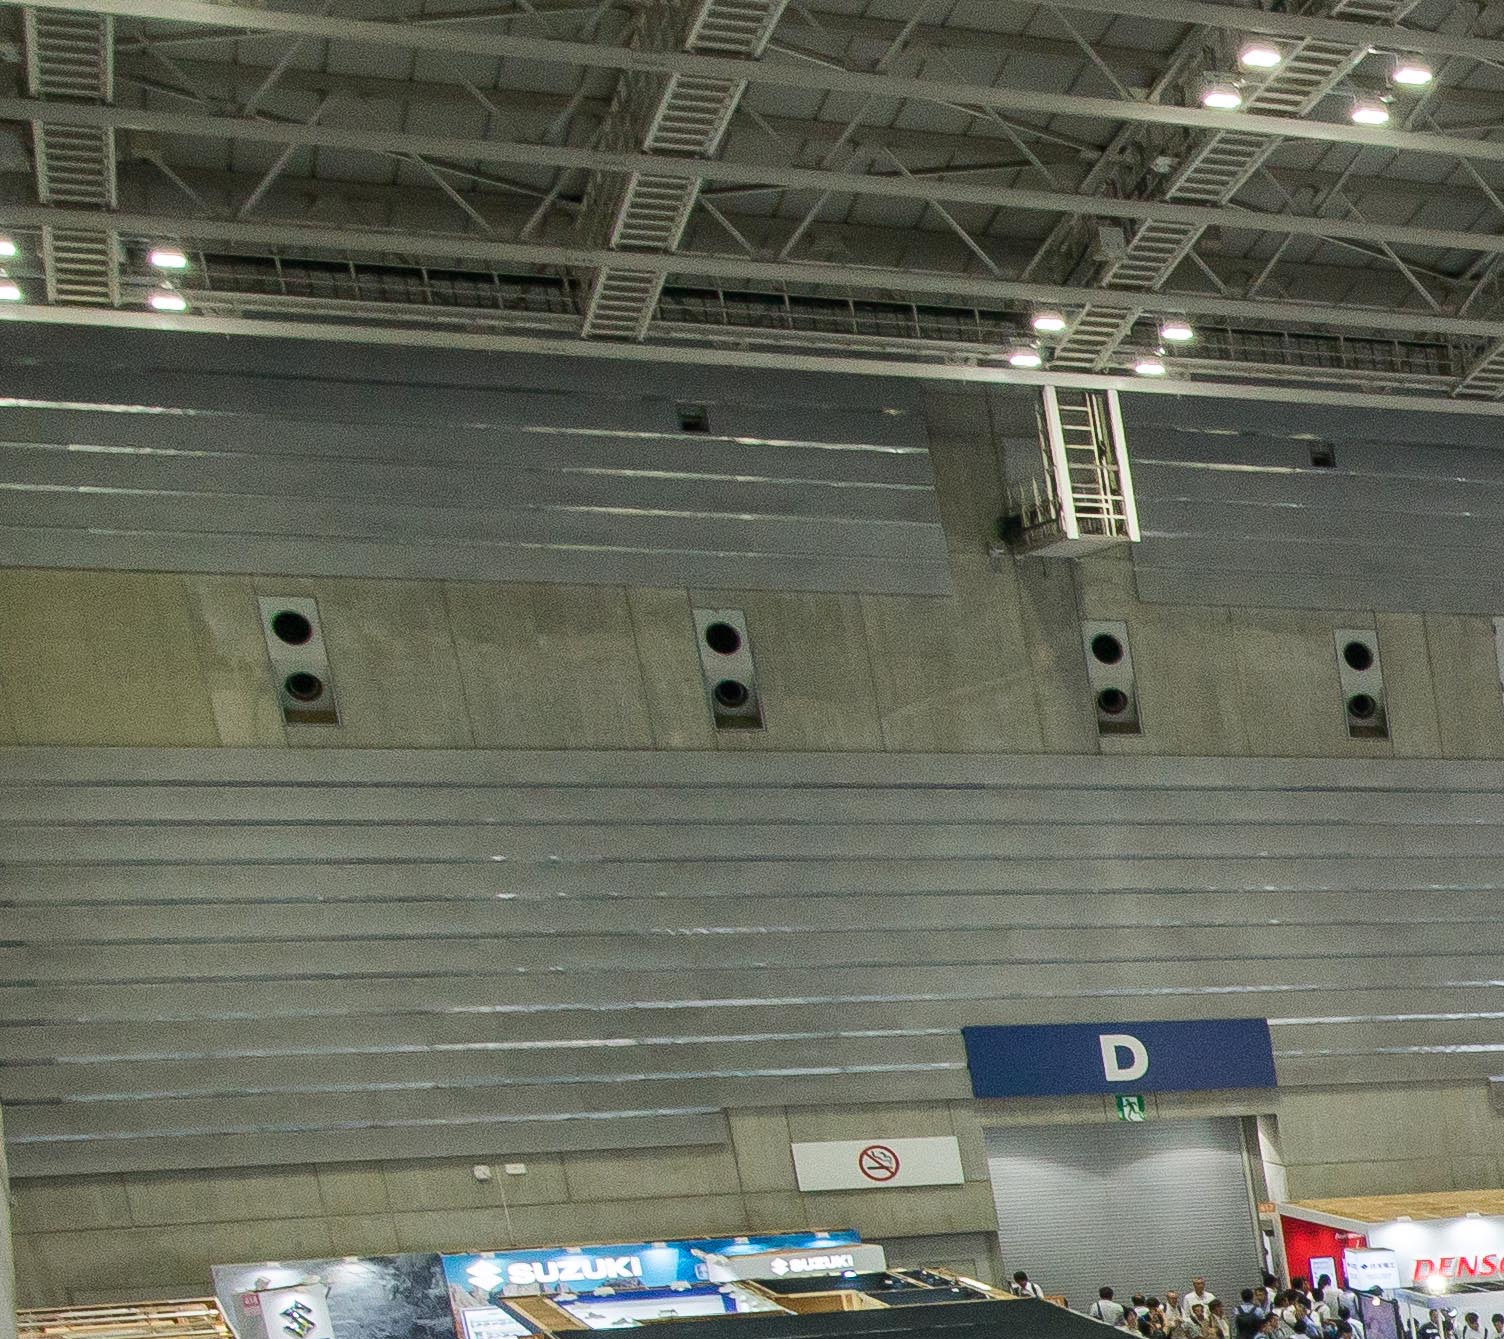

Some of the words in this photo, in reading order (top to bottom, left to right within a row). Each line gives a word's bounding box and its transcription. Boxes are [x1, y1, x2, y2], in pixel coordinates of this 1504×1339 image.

[1100, 1035, 1149, 1082] D
[507, 1257, 643, 1285] SUZUKI
[788, 1254, 854, 1272] SUZUKI
